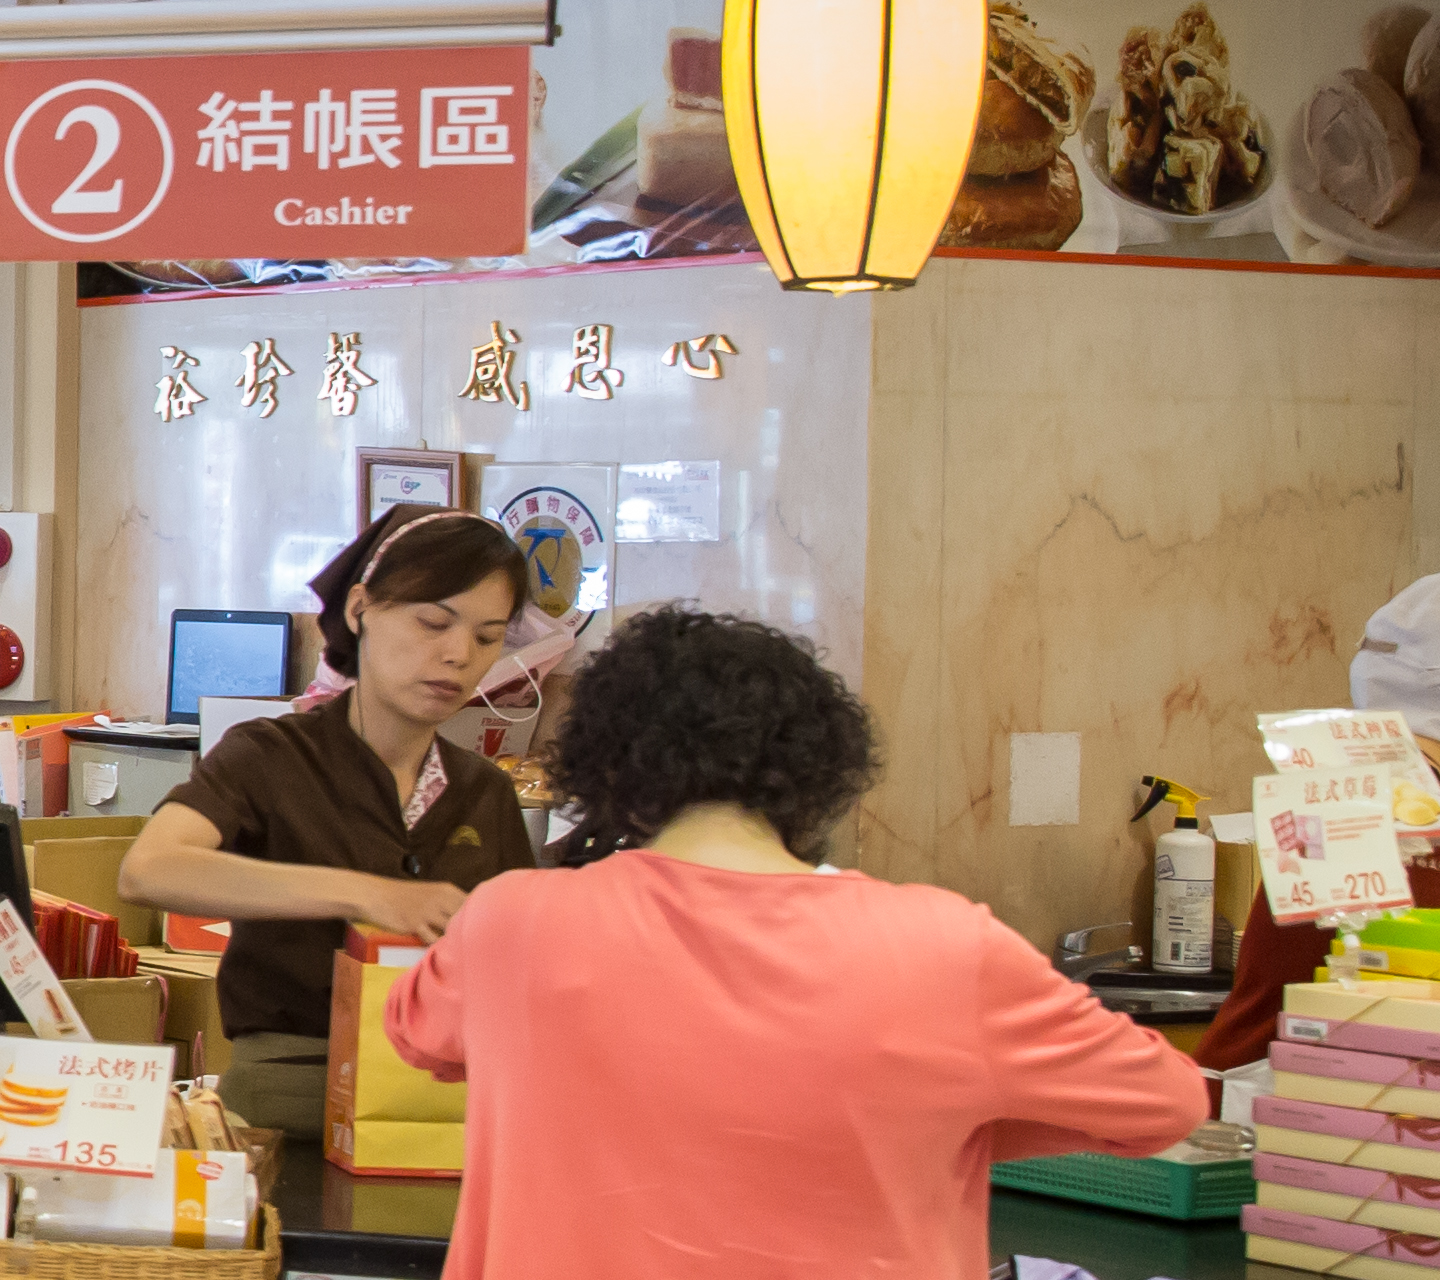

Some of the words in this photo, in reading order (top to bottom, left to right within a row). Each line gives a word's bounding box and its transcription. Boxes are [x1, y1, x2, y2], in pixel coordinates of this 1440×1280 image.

[195, 85, 516, 172] 結帳區
[51, 105, 125, 214] 2
[273, 197, 414, 227] Cashier
[153, 331, 380, 423] 裕珍馨
[456, 320, 739, 412] 感恩心
[1291, 748, 1314, 768] 40
[1292, 881, 1316, 907] 45
[1344, 871, 1387, 900] 270
[58, 1056, 164, 1081] 法式烤片
[54, 1140, 118, 1167] 135
